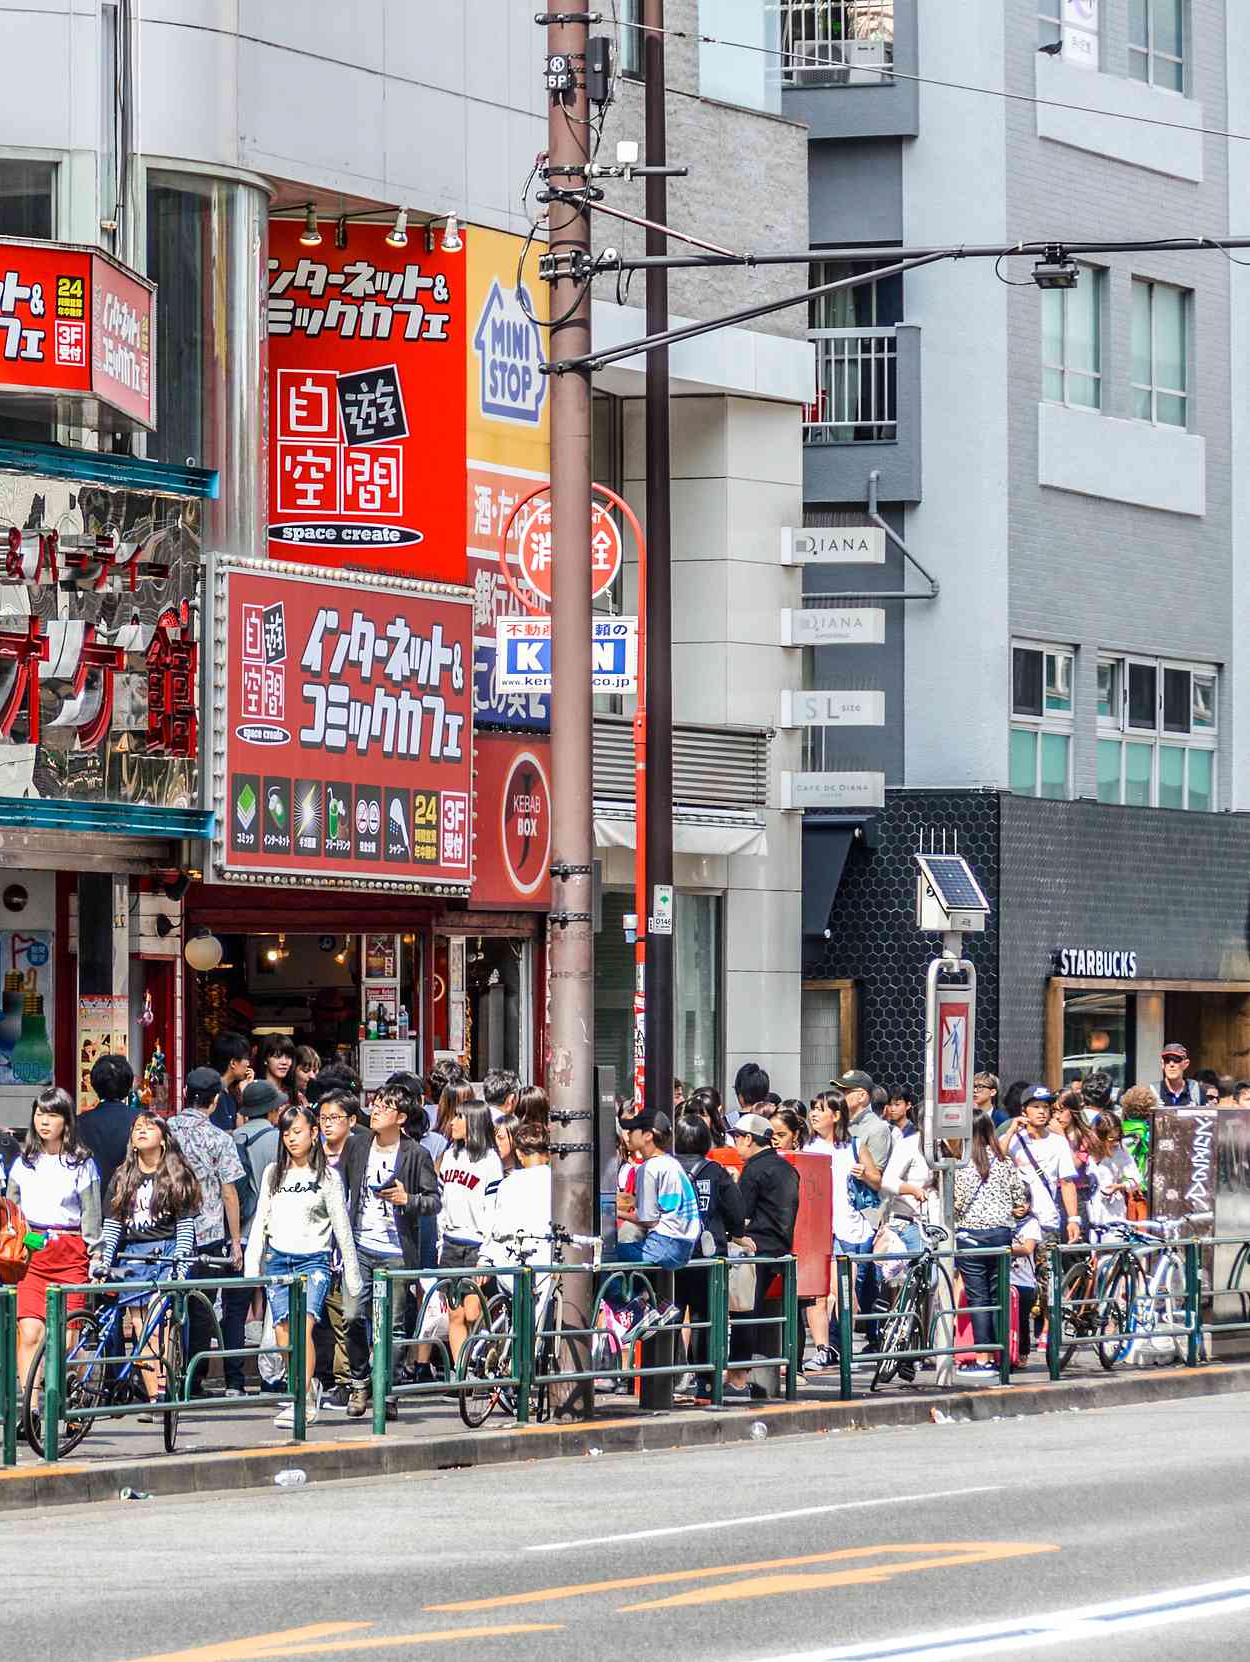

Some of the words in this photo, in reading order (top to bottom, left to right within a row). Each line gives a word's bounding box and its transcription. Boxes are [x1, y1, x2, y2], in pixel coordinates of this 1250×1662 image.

[57, 278, 83, 298] 24
[268, 259, 450, 302] ンターネット&
[58, 325, 82, 345] 3F
[268, 299, 450, 341] ミックカフェ
[490, 318, 531, 360] MINI
[488, 358, 532, 403] STOP
[289, 377, 398, 437] 自遊
[285, 449, 398, 510] 空間
[282, 525, 337, 541] space
[341, 526, 401, 542] create
[806, 535, 870, 554] DIANA
[301, 608, 464, 692] インターネット&
[516, 641, 615, 672] KN
[300, 682, 464, 758] コミックカフェ
[414, 795, 438, 825] 24
[443, 799, 466, 831] 3F
[513, 795, 542, 814] KEBAB
[517, 818, 538, 837] BOX
[443, 832, 463, 859] 受付
[1060, 948, 1137, 978] STARBUCKS
